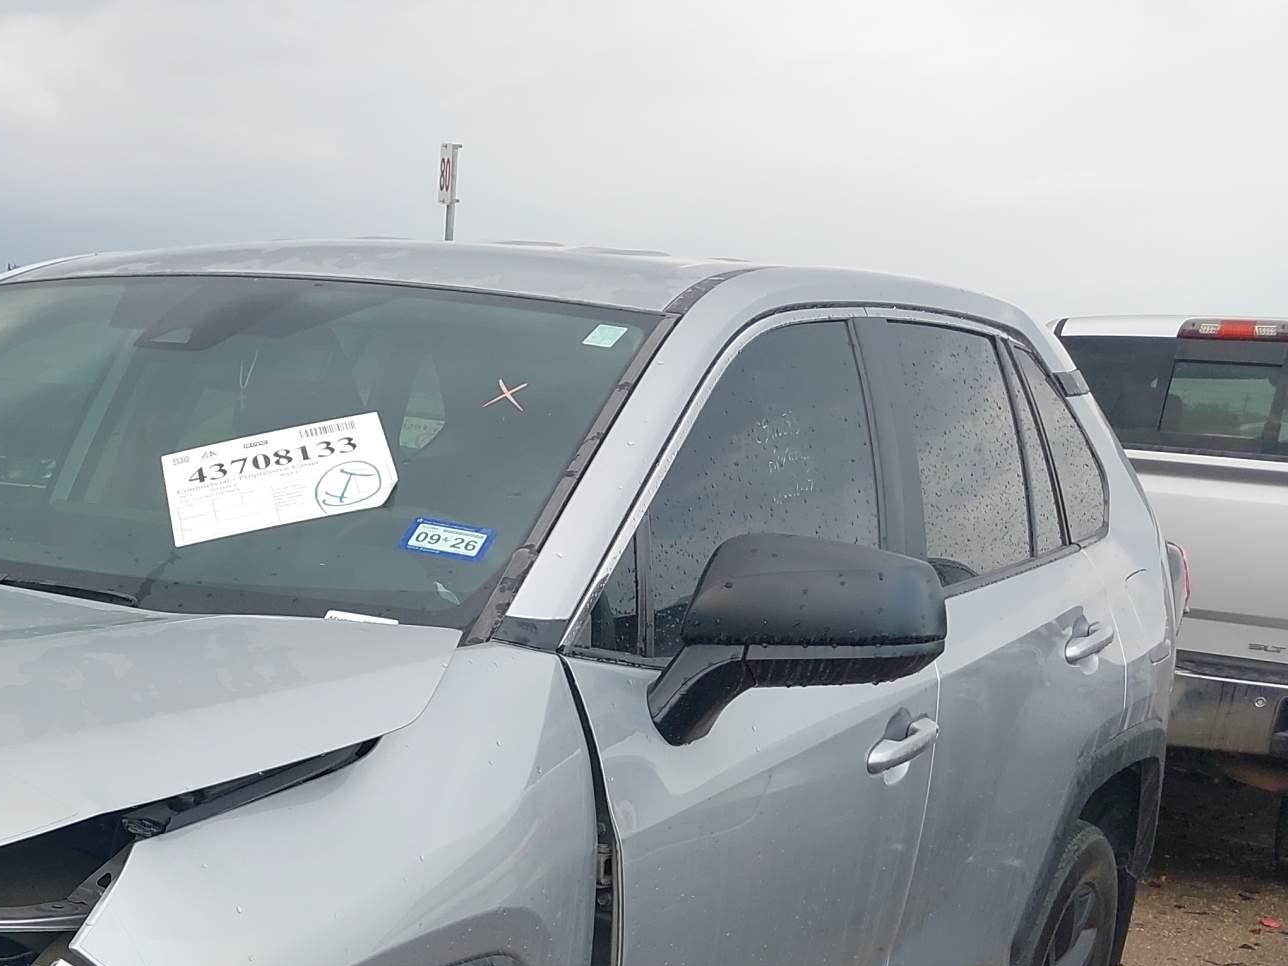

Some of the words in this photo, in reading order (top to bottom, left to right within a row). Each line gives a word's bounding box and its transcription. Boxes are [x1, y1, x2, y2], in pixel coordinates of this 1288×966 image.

[439, 157, 451, 192] 80
[188, 436, 357, 484] 43708133
[415, 531, 441, 545] 09
[450, 537, 478, 552] 26
